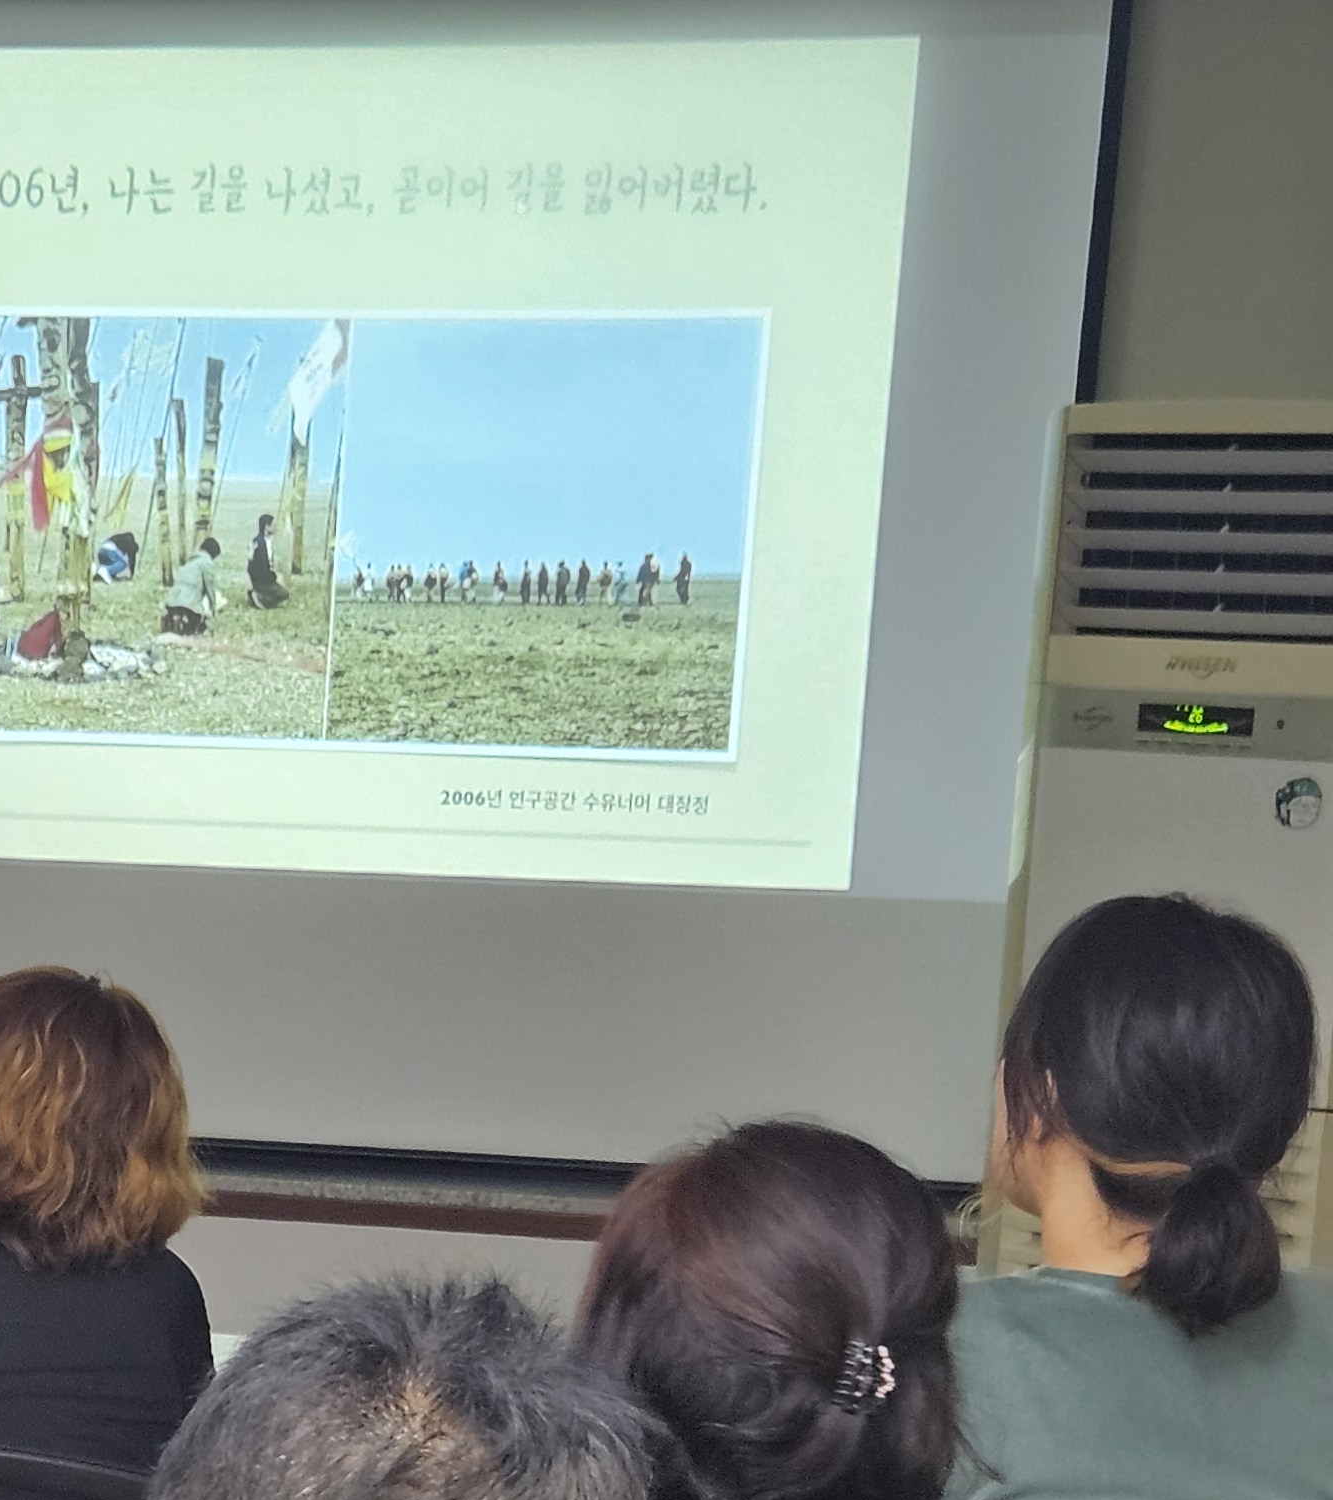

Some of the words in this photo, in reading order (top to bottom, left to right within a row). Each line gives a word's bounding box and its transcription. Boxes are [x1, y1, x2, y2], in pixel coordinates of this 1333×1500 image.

[108, 165, 174, 216] 나는
[189, 163, 248, 215] 길을
[265, 166, 375, 217] 나섰고,
[440, 789, 503, 809] 2006년
